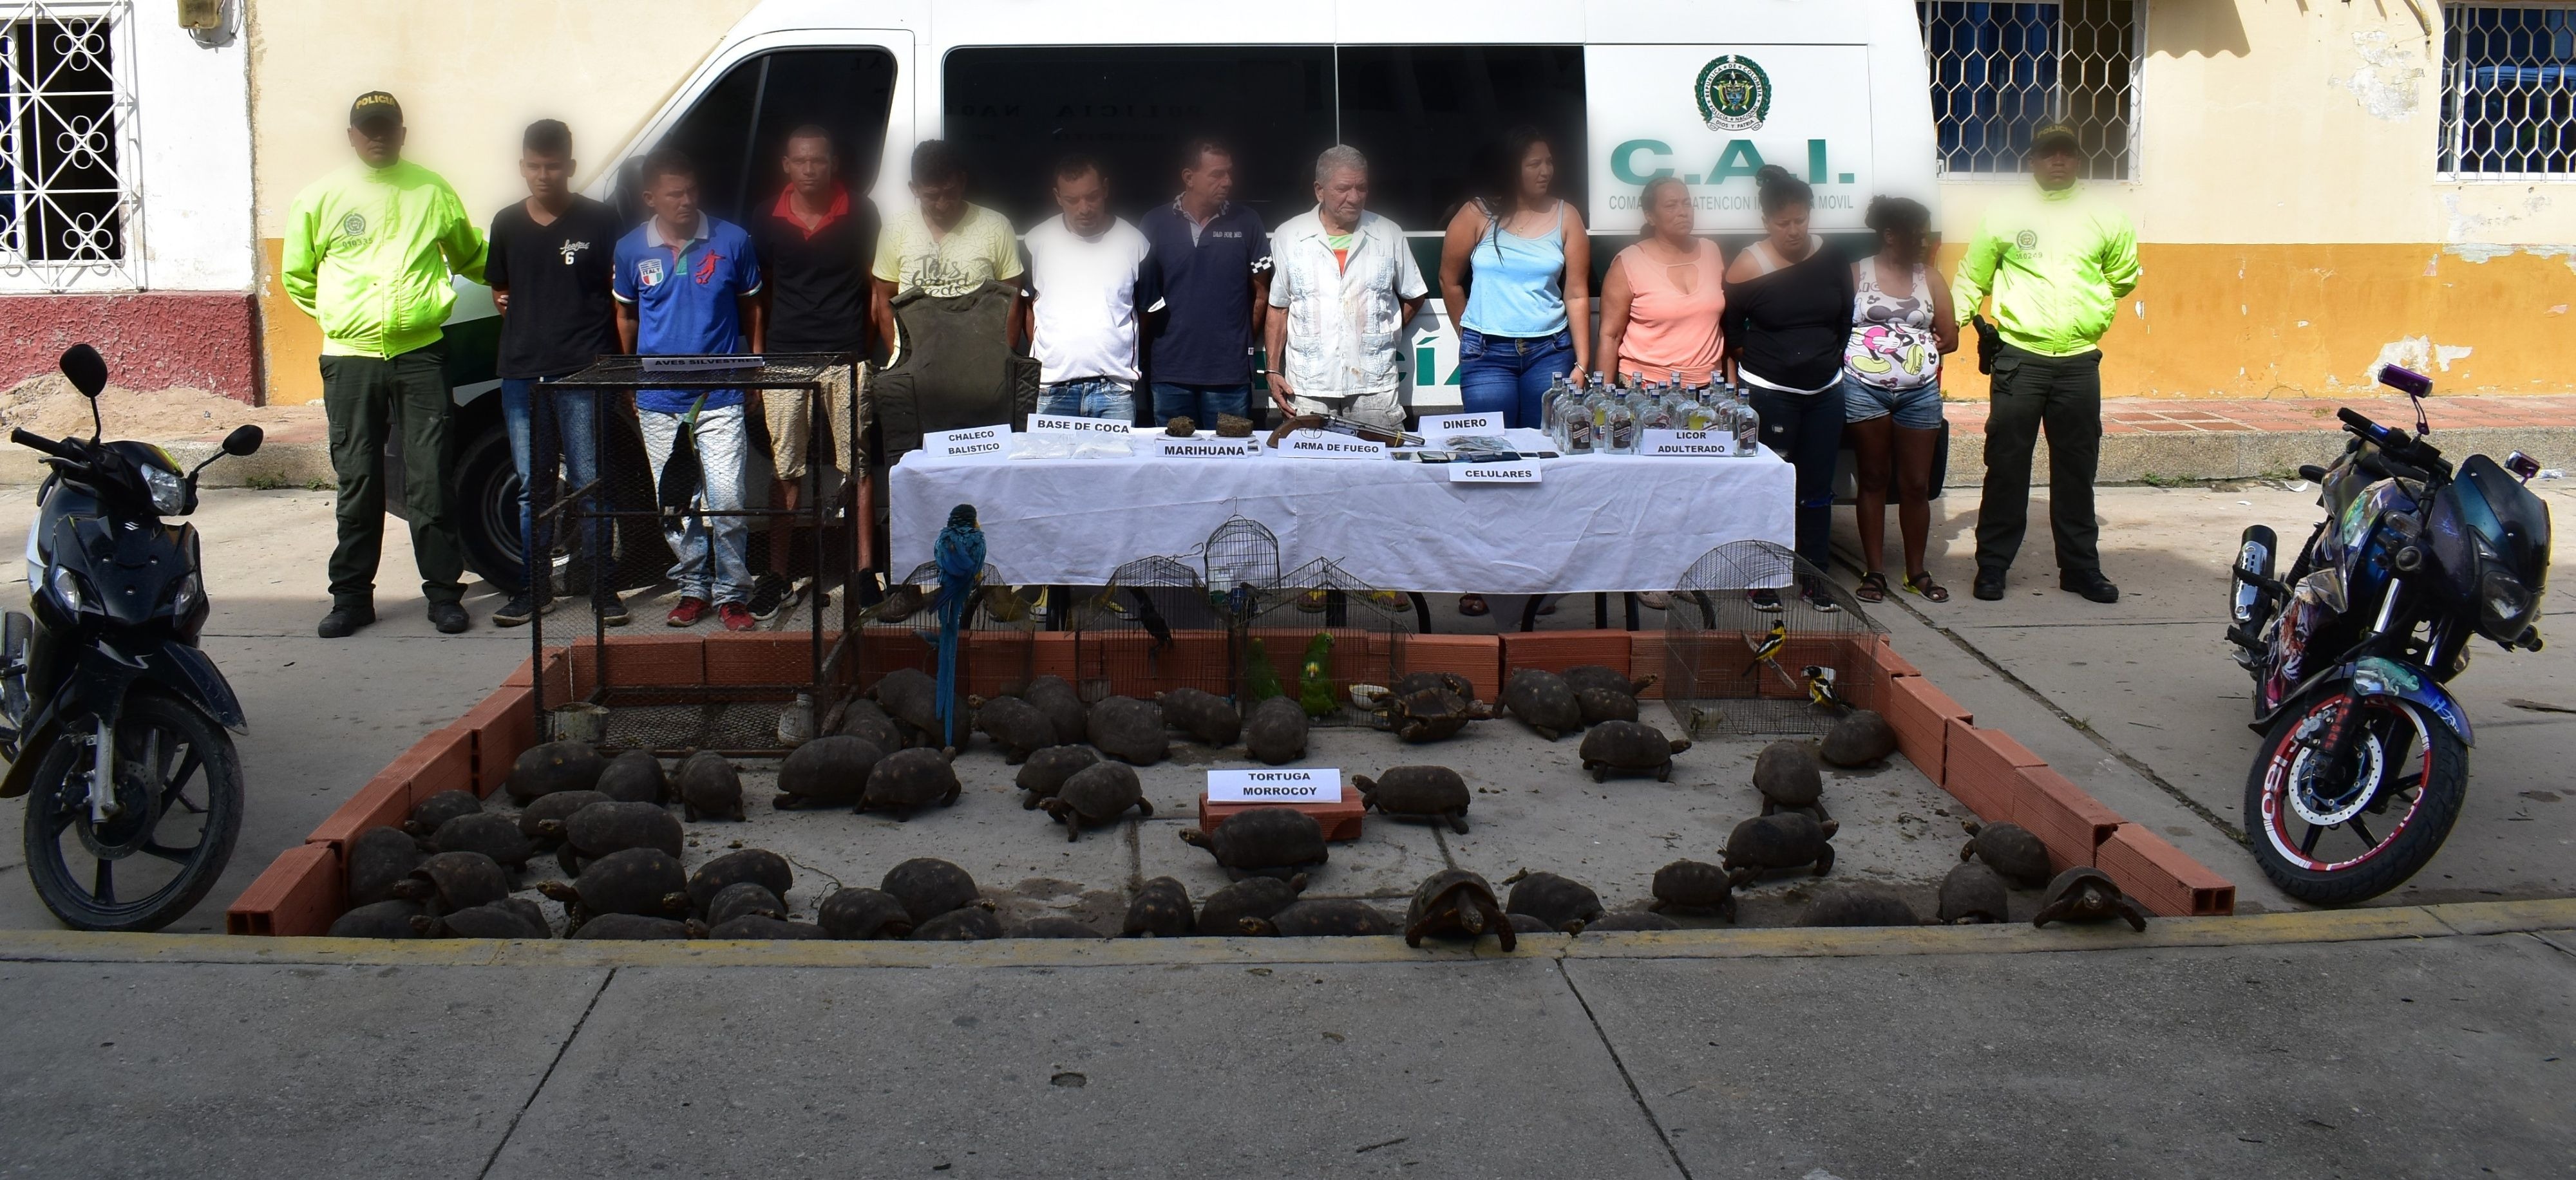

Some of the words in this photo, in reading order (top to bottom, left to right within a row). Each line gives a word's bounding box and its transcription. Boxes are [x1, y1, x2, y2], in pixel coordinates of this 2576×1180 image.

[1705, 67, 1723, 97] REPUBLICA
[1743, 66, 1762, 97] COLOMBIA
[355, 95, 395, 109] POLICIA
[1735, 105, 1758, 121] NACIONAL
[1716, 120, 1728, 128] DIOS
[1737, 119, 1754, 129] PATRIA
[2037, 125, 2075, 138] POLICIA
[1693, 196, 1750, 211] ATENCION
[1818, 195, 1854, 210] MOVIL
[565, 251, 575, 265] 6
[643, 267, 661, 276] ITALY
[1037, 420, 1070, 429] BASE
[1074, 422, 1091, 431] DE
[1094, 423, 1130, 433] COCA
[1443, 418, 1487, 429] DINERO
[948, 430, 994, 442] CHALECO
[948, 442, 1000, 455] BALISTICO
[1164, 445, 1245, 456] MARIHUANA
[1293, 442, 1324, 451] ARMA
[1343, 444, 1379, 453] FUEGO
[1248, 773, 1311, 781] TORTUGA
[1243, 787, 1317, 796] MORROCOY
